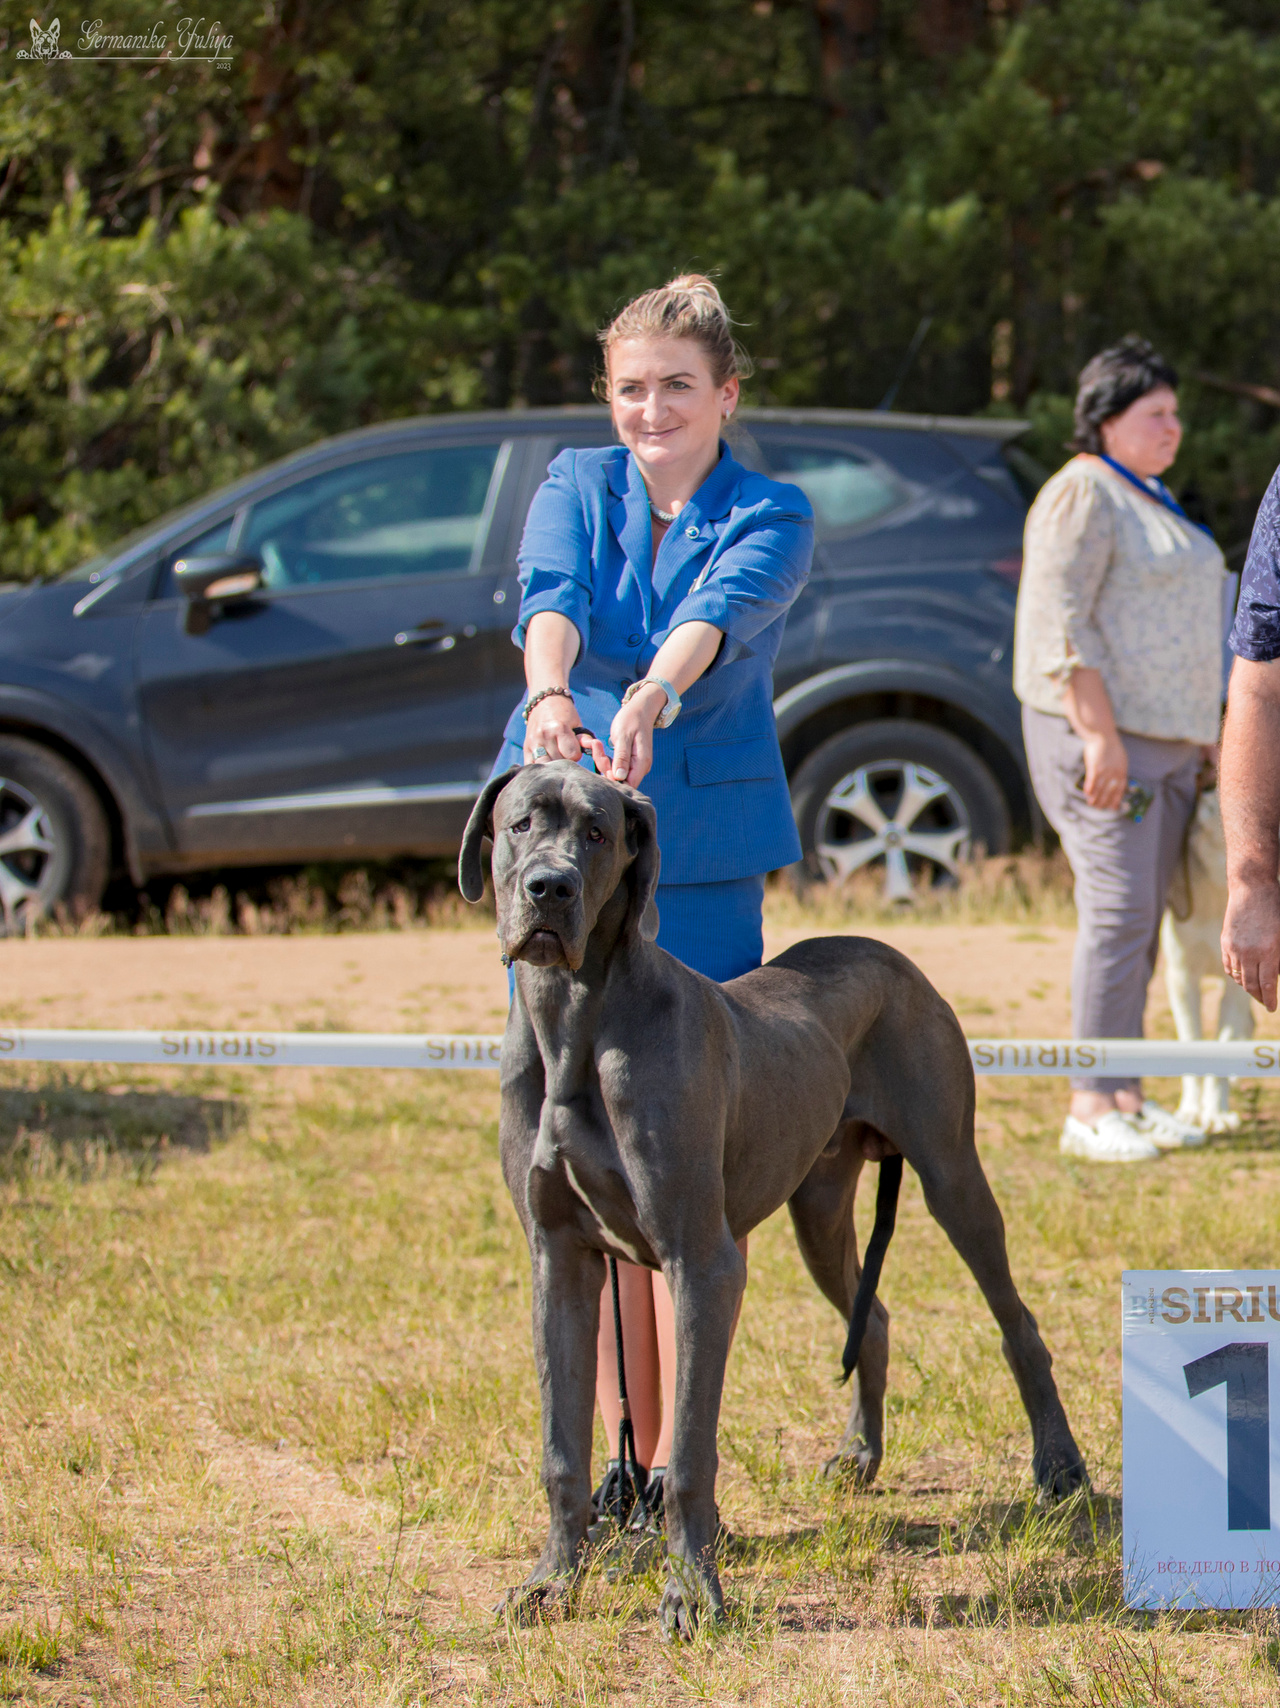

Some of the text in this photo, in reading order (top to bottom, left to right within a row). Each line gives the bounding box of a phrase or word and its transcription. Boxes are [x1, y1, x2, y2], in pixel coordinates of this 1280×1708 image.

[161, 1036, 278, 1058] SIRIUS
[975, 1044, 1098, 1069] SIRIUS
[1182, 1342, 1271, 1531] 1
[1157, 1561, 1187, 1574] ВСЕ
[1190, 1560, 1235, 1575] ДЕЛО
[1240, 1561, 1249, 1574] В
